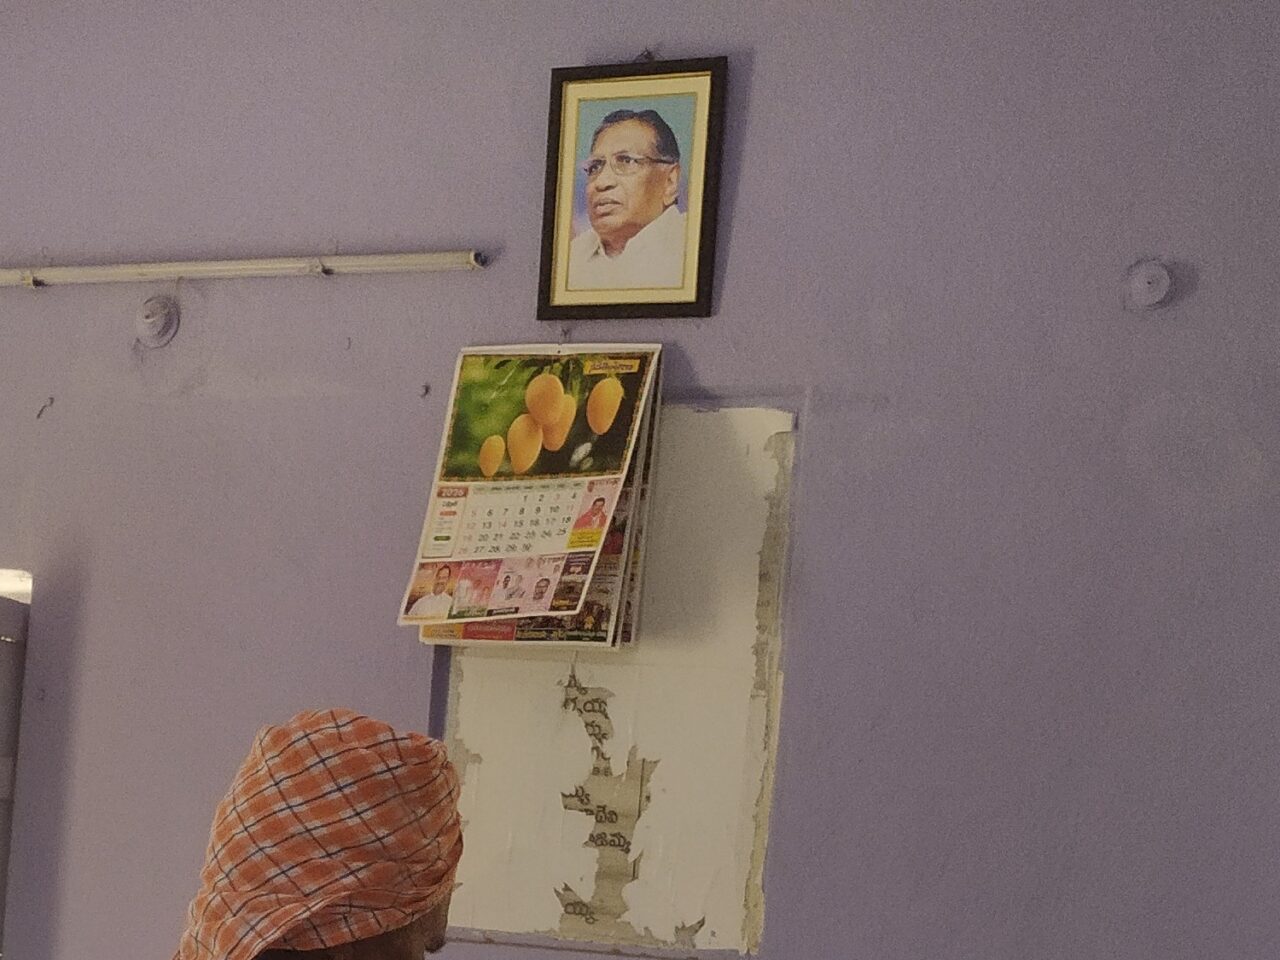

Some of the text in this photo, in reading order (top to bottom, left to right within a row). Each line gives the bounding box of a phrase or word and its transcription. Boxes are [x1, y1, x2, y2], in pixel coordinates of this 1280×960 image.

[538, 494, 544, 502] 2
[487, 509, 493, 517] 6
[502, 508, 509, 516] 7
[519, 507, 525, 516] 8
[534, 506, 541, 515] 9
[549, 505, 560, 514] 10
[481, 521, 492, 530] 13
[513, 520, 524, 528] 15
[561, 516, 572, 524] 18
[473, 545, 485, 554] 27
